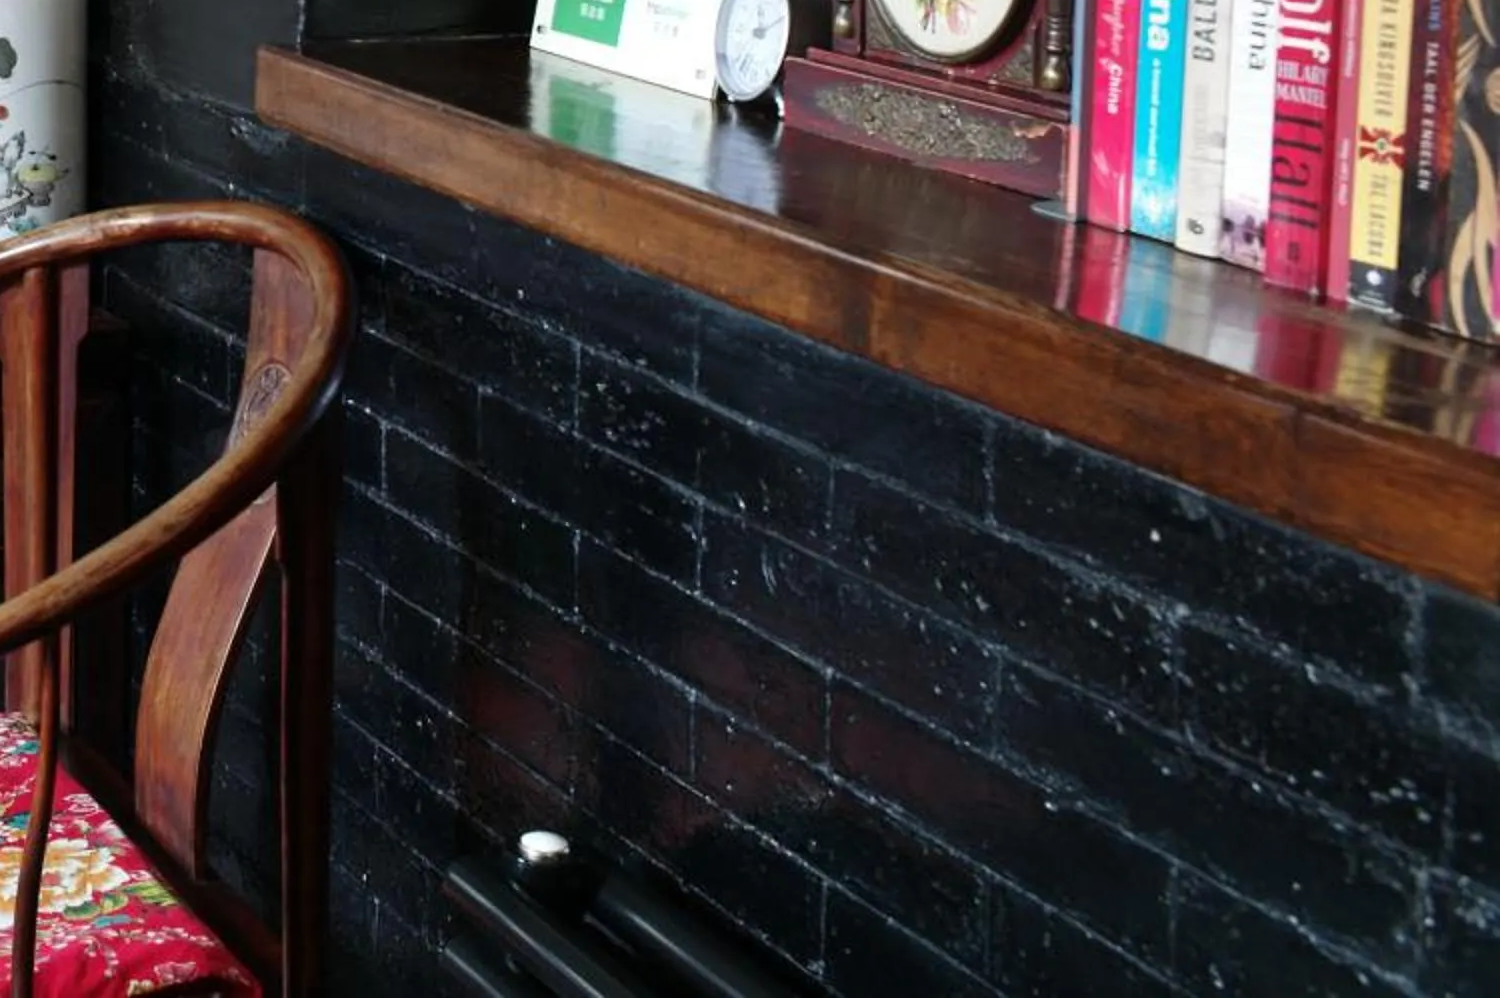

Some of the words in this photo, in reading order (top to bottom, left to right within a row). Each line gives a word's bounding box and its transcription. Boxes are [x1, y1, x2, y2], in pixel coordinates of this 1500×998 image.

[1425, 41, 1441, 75] TAAL
[1107, 62, 1123, 115] China
[1421, 82, 1438, 115] DER
[1270, 112, 1324, 230] Hall
[1416, 118, 1437, 192] ENGELEN
